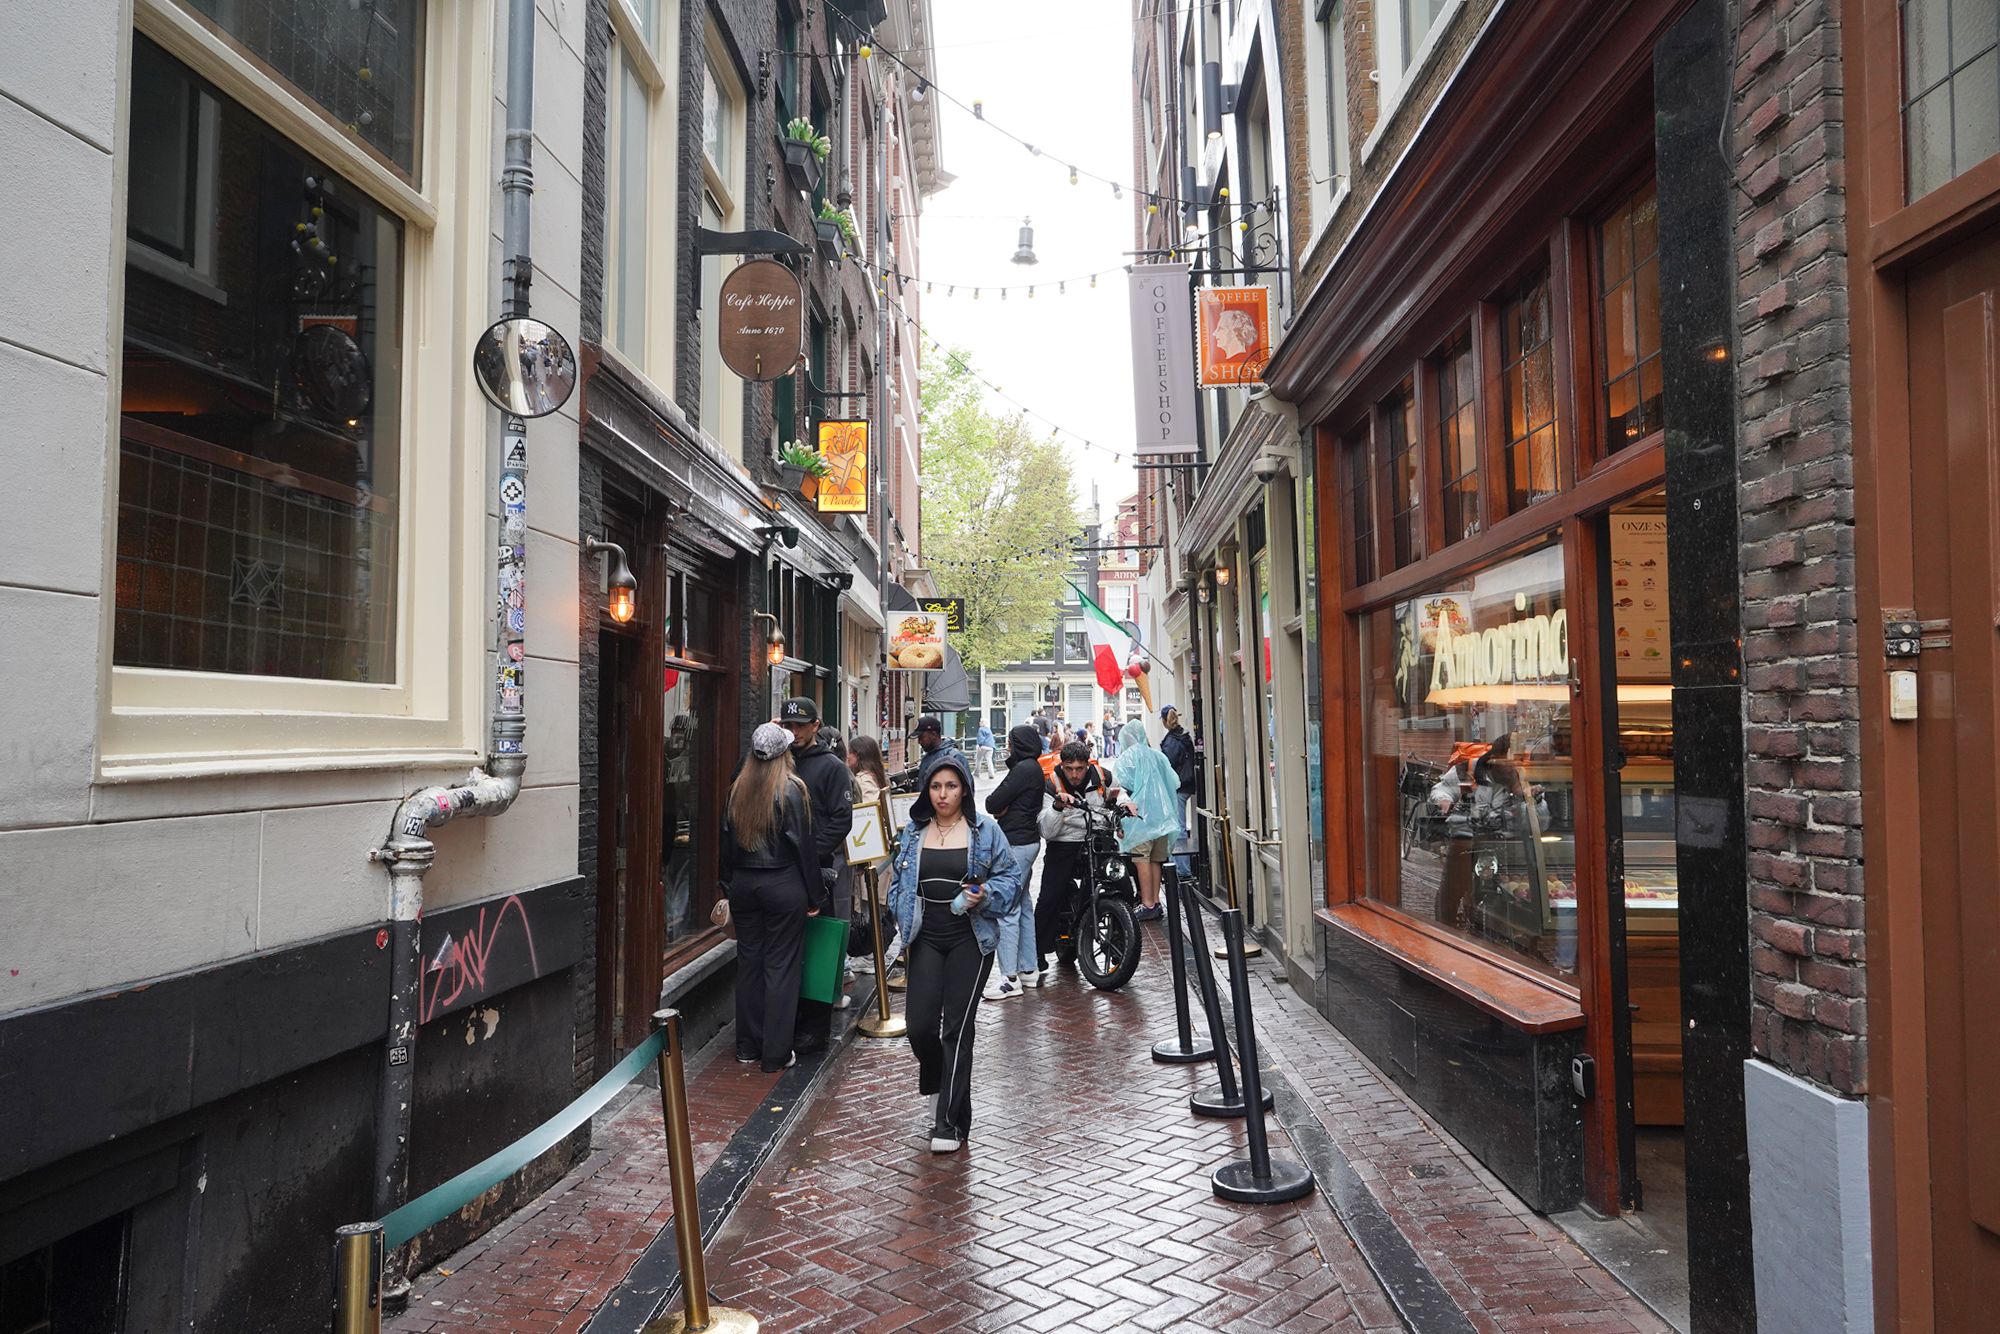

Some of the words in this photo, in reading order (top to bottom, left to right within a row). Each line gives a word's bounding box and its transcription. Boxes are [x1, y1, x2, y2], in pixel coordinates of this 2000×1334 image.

[726, 293, 753, 311] Cafe
[755, 293, 796, 311] Hoppe
[1207, 291, 1260, 302] COFFEE
[737, 325, 762, 335] Anno
[764, 326, 785, 335] 1670
[1153, 285, 1172, 440] COFFEESHOP
[1209, 364, 1263, 380] SHOP
[1621, 521, 1652, 531] ONZE
